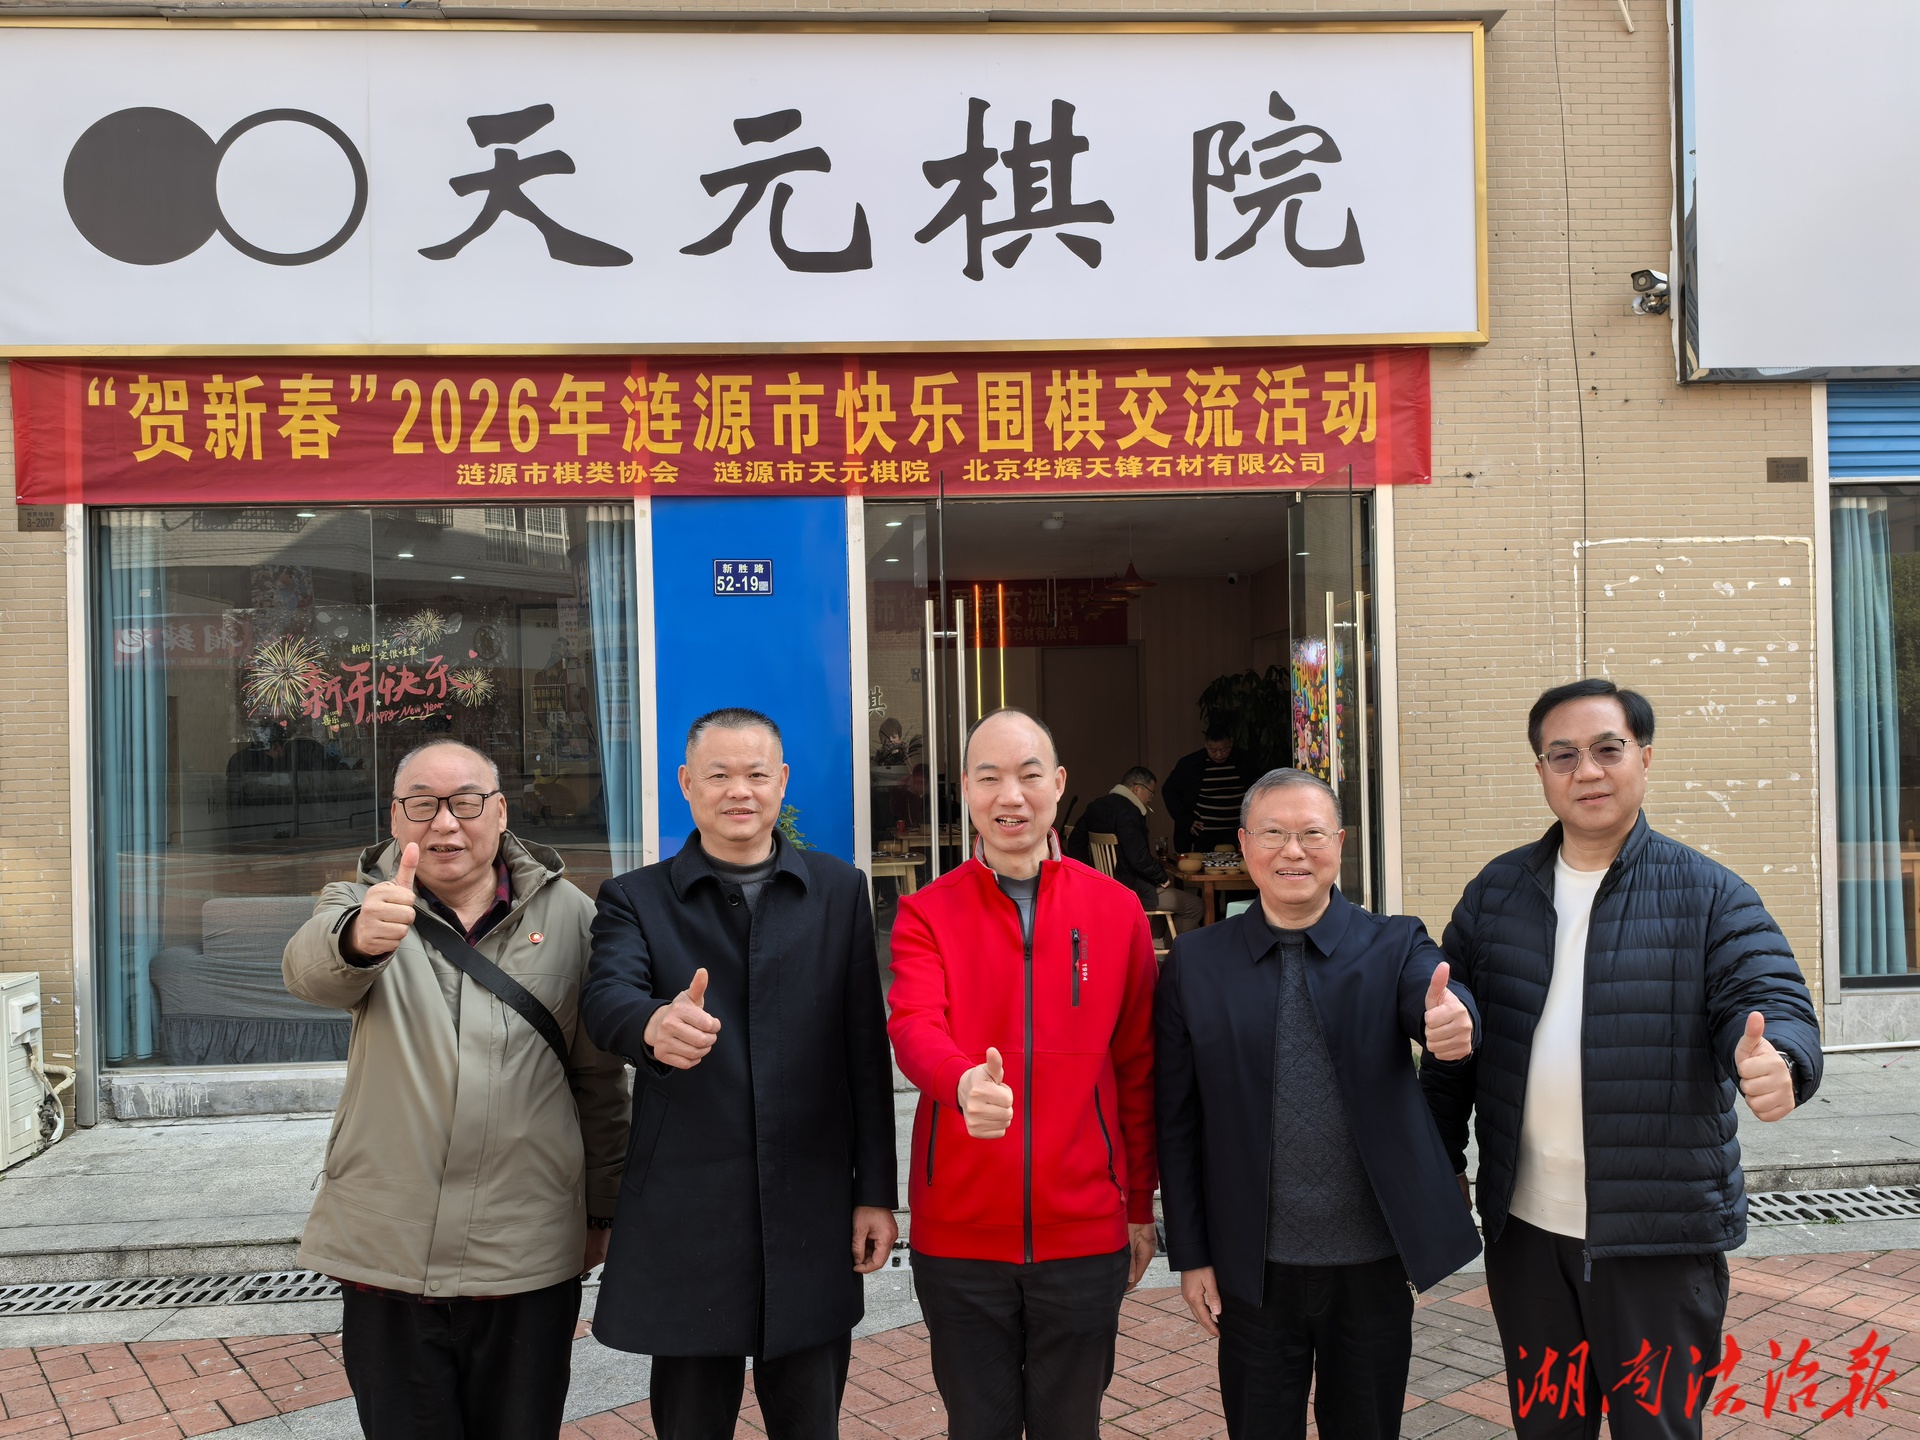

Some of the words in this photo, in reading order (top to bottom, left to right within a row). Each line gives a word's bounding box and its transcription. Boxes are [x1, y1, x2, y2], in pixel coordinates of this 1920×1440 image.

[418, 91, 1364, 281] 天元棋院
[456, 460, 679, 486] 涟源市棋类协会
[713, 458, 930, 484] 涟源市天元棋院
[962, 451, 1326, 481] 北京华辉天锋石材有限公司
[26, 517, 55, 528] 3-2007
[722, 563, 764, 574] 新胜路
[717, 575, 759, 591] 52-19
[351, 639, 390, 654] 新的一年
[300, 655, 473, 724] 新年快乐
[398, 705, 421, 718] New
[419, 702, 445, 720] Year
